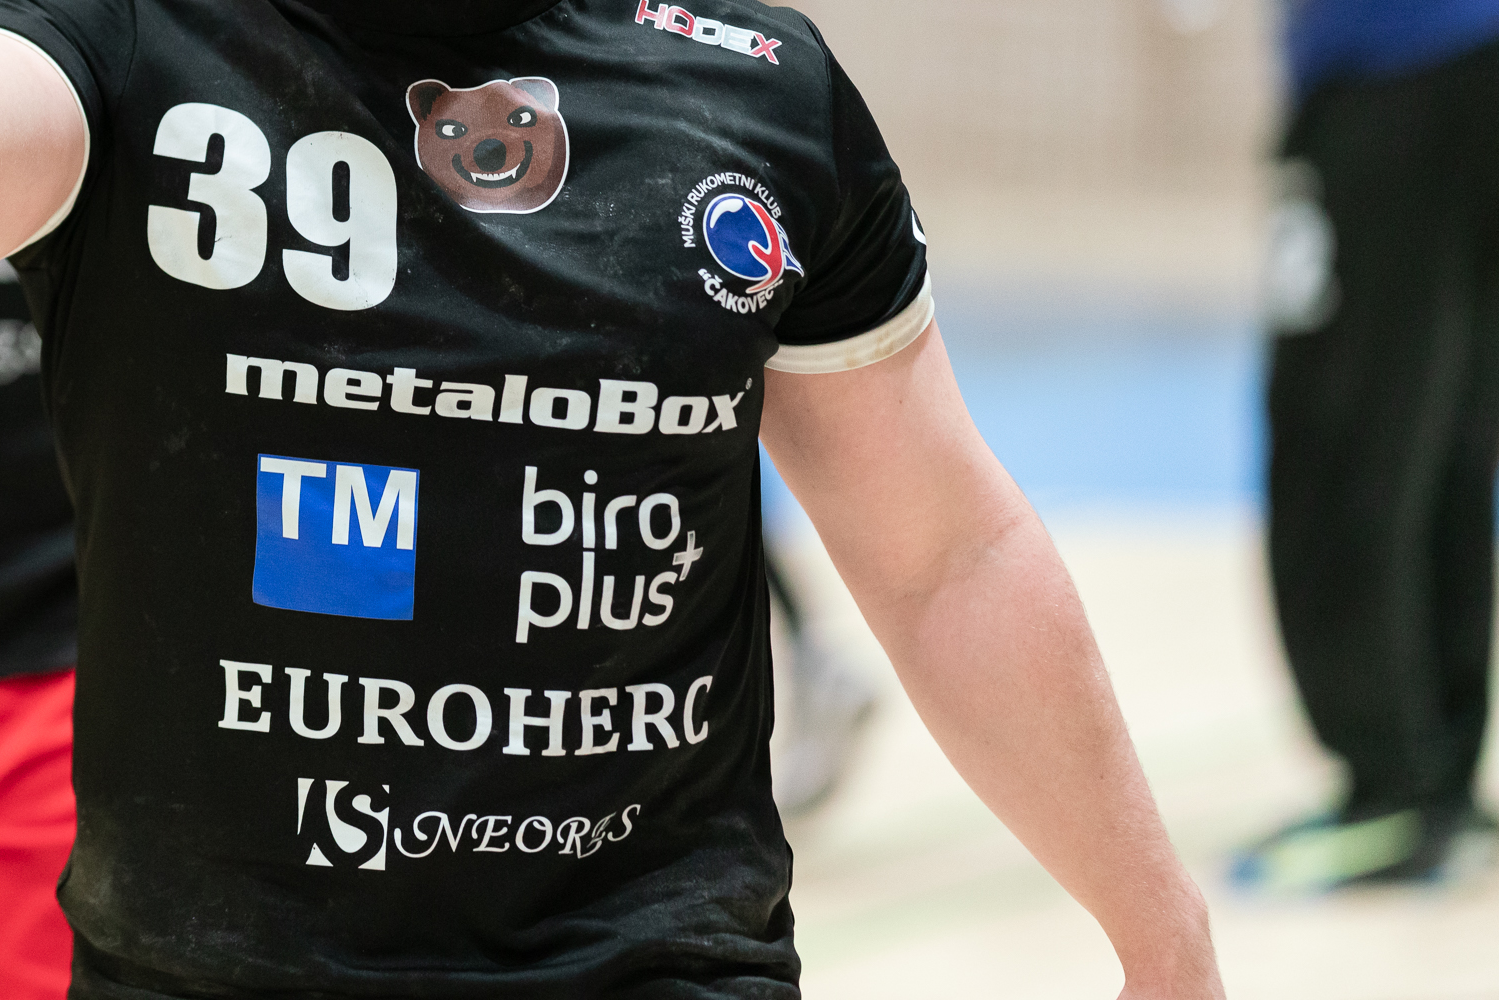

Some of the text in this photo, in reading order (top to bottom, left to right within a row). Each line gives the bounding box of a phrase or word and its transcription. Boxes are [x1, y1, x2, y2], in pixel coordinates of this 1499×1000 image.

[147, 102, 398, 311] 39
[677, 171, 782, 248] MUŠKI RUKOMETNI KLUB
[259, 456, 419, 551] TM
[521, 465, 682, 551] biro
[217, 658, 714, 758] EUROHERC
